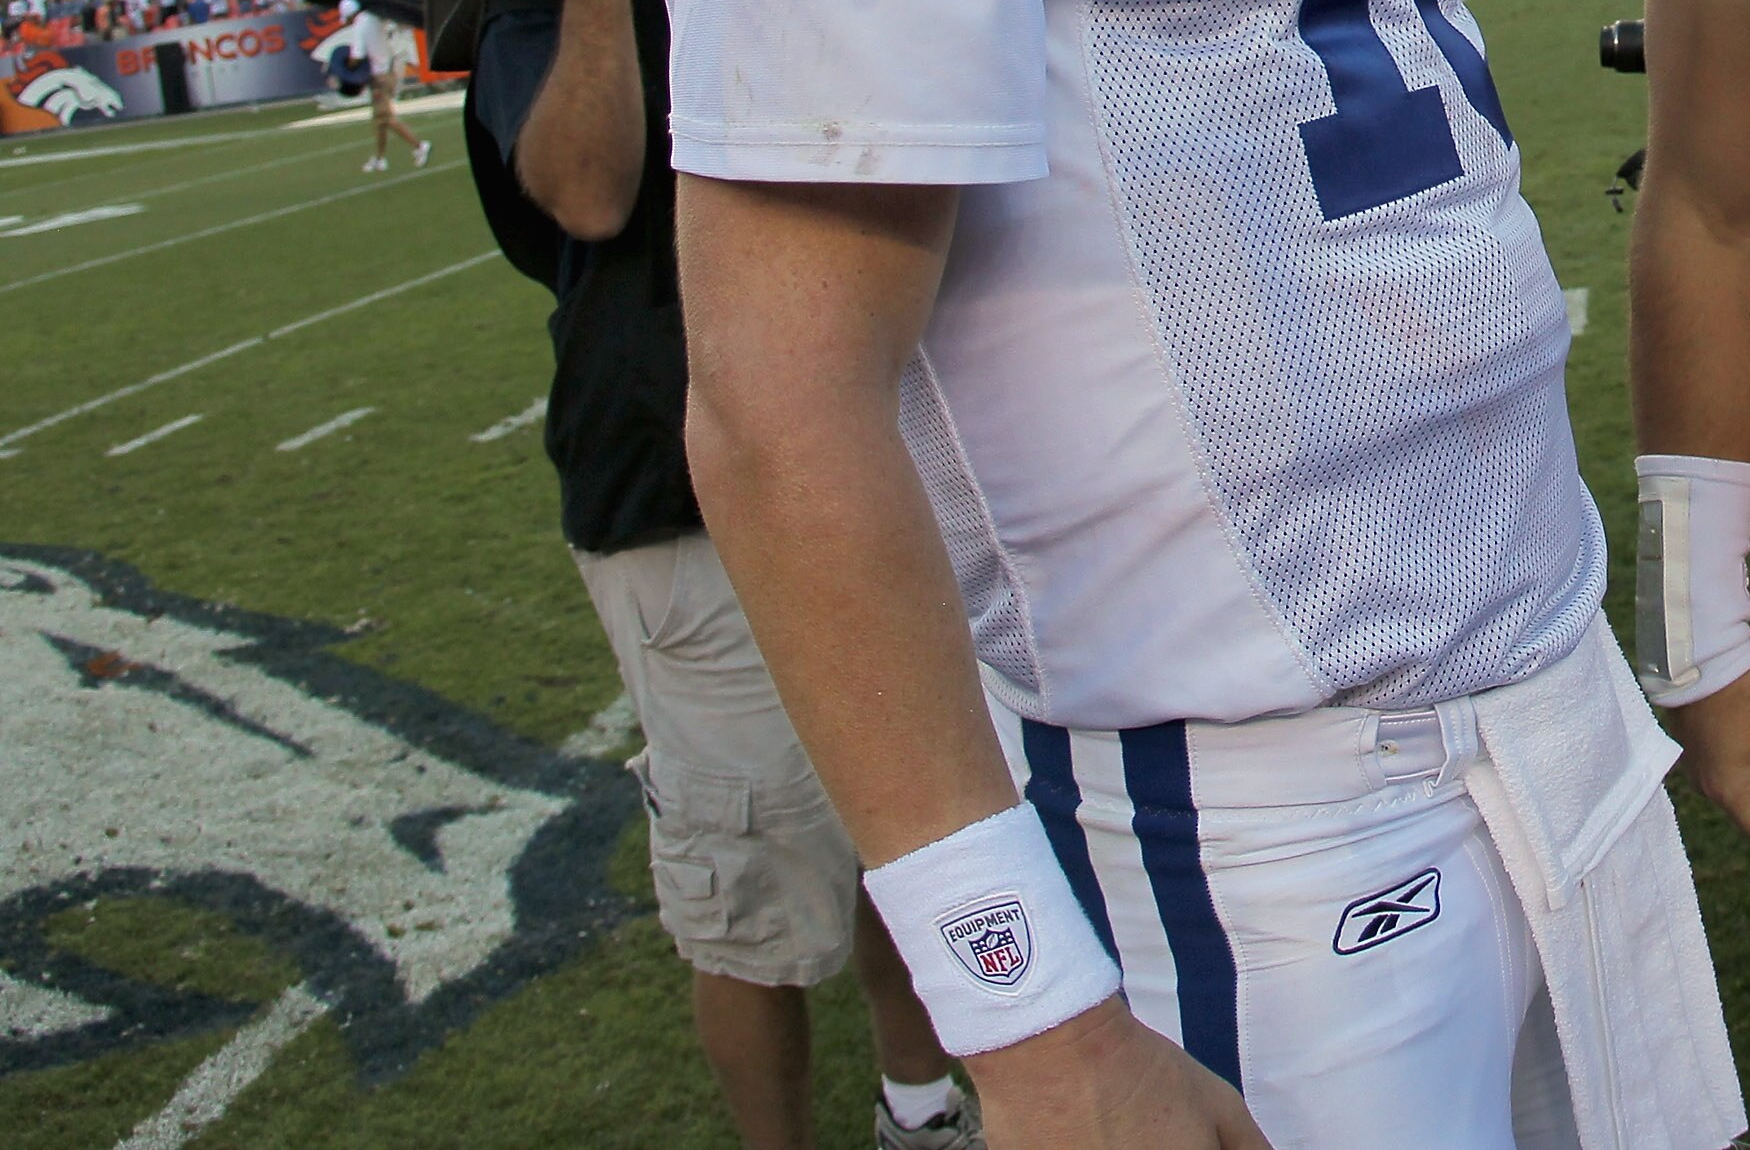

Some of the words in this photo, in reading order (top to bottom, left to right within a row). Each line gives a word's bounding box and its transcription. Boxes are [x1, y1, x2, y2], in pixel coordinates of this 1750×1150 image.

[115, 23, 288, 77] BRNCOS
[948, 908, 1022, 943] EQUIPMENT
[979, 946, 1020, 974] NFL
